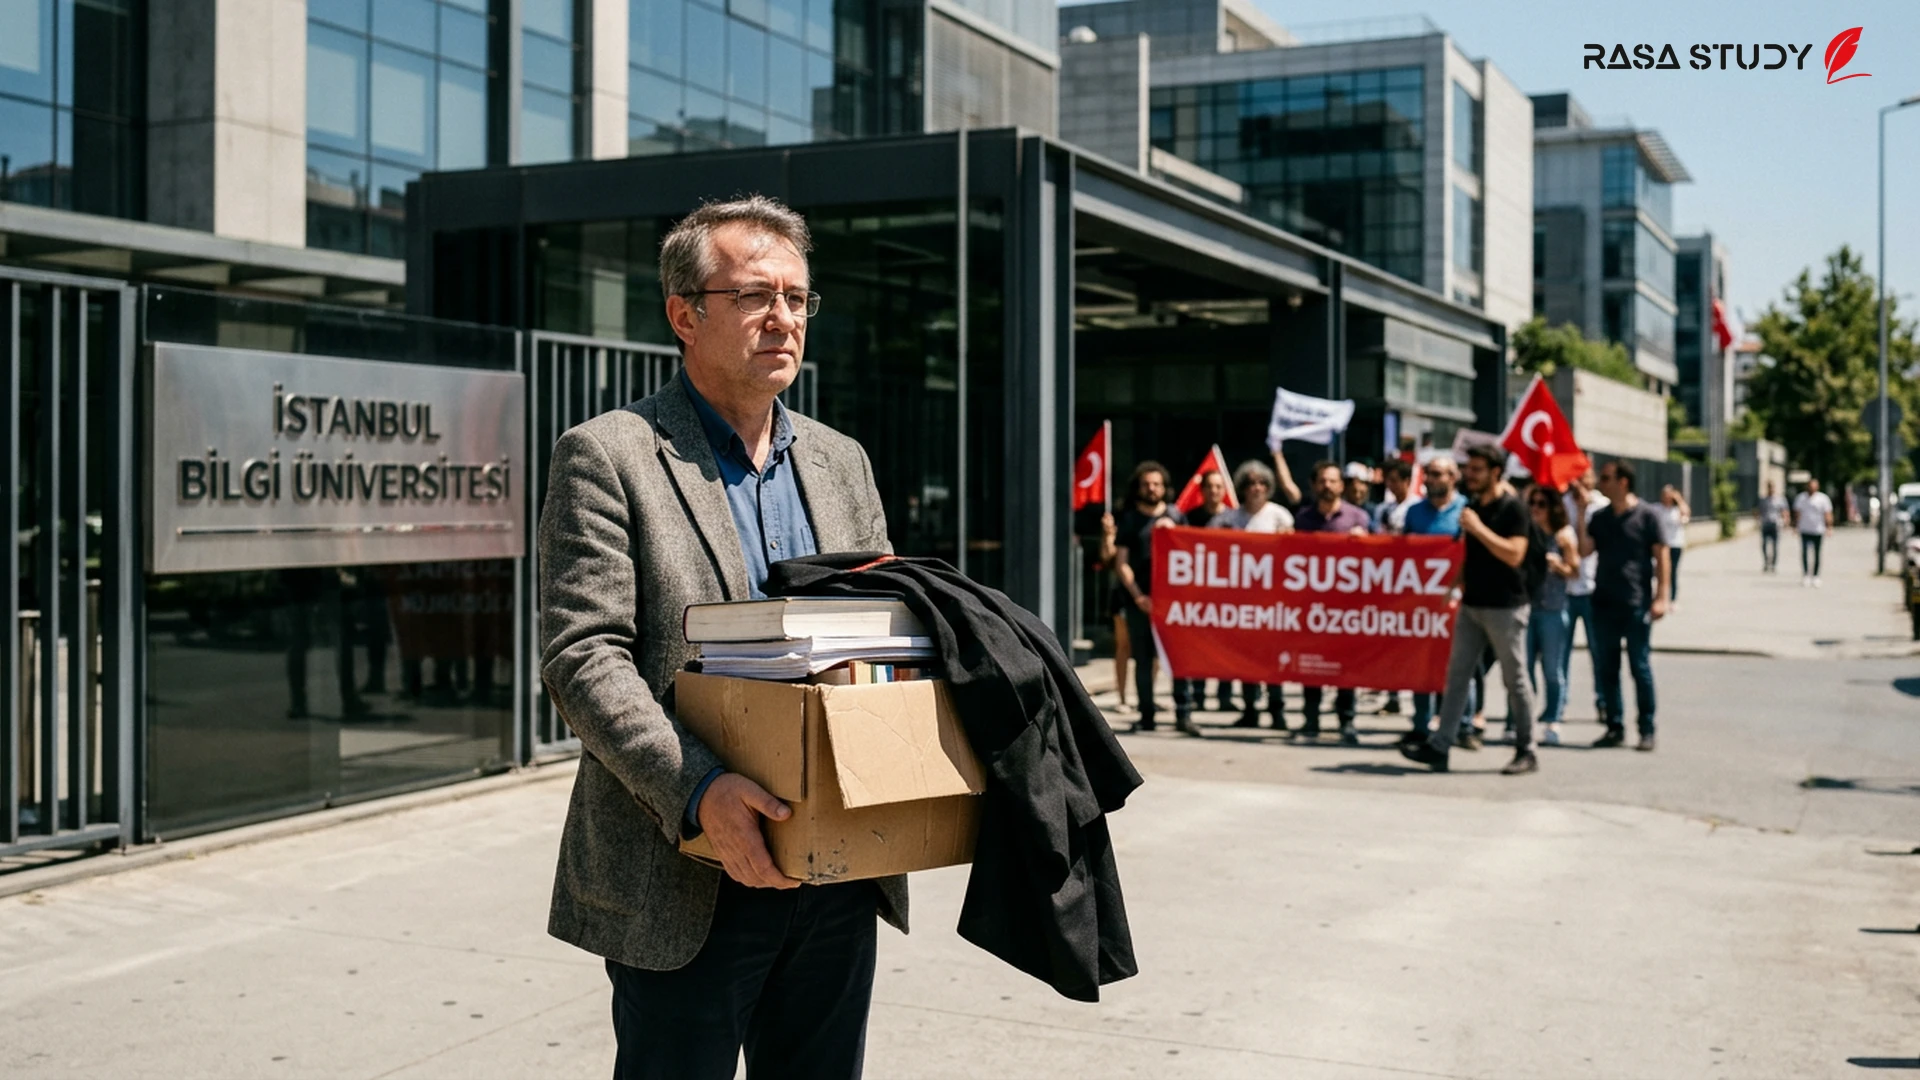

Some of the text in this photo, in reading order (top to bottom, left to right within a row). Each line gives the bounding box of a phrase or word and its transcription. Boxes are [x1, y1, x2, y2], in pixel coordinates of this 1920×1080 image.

[273, 381, 441, 440] İSTANBUL
[178, 446, 511, 504] BİLGİ ÜNİVERSİTESİ
[1167, 543, 1452, 595] BİLİM SUSMAZ
[1165, 601, 1450, 639] AKADEMİK ÖZGÜRLÜK
